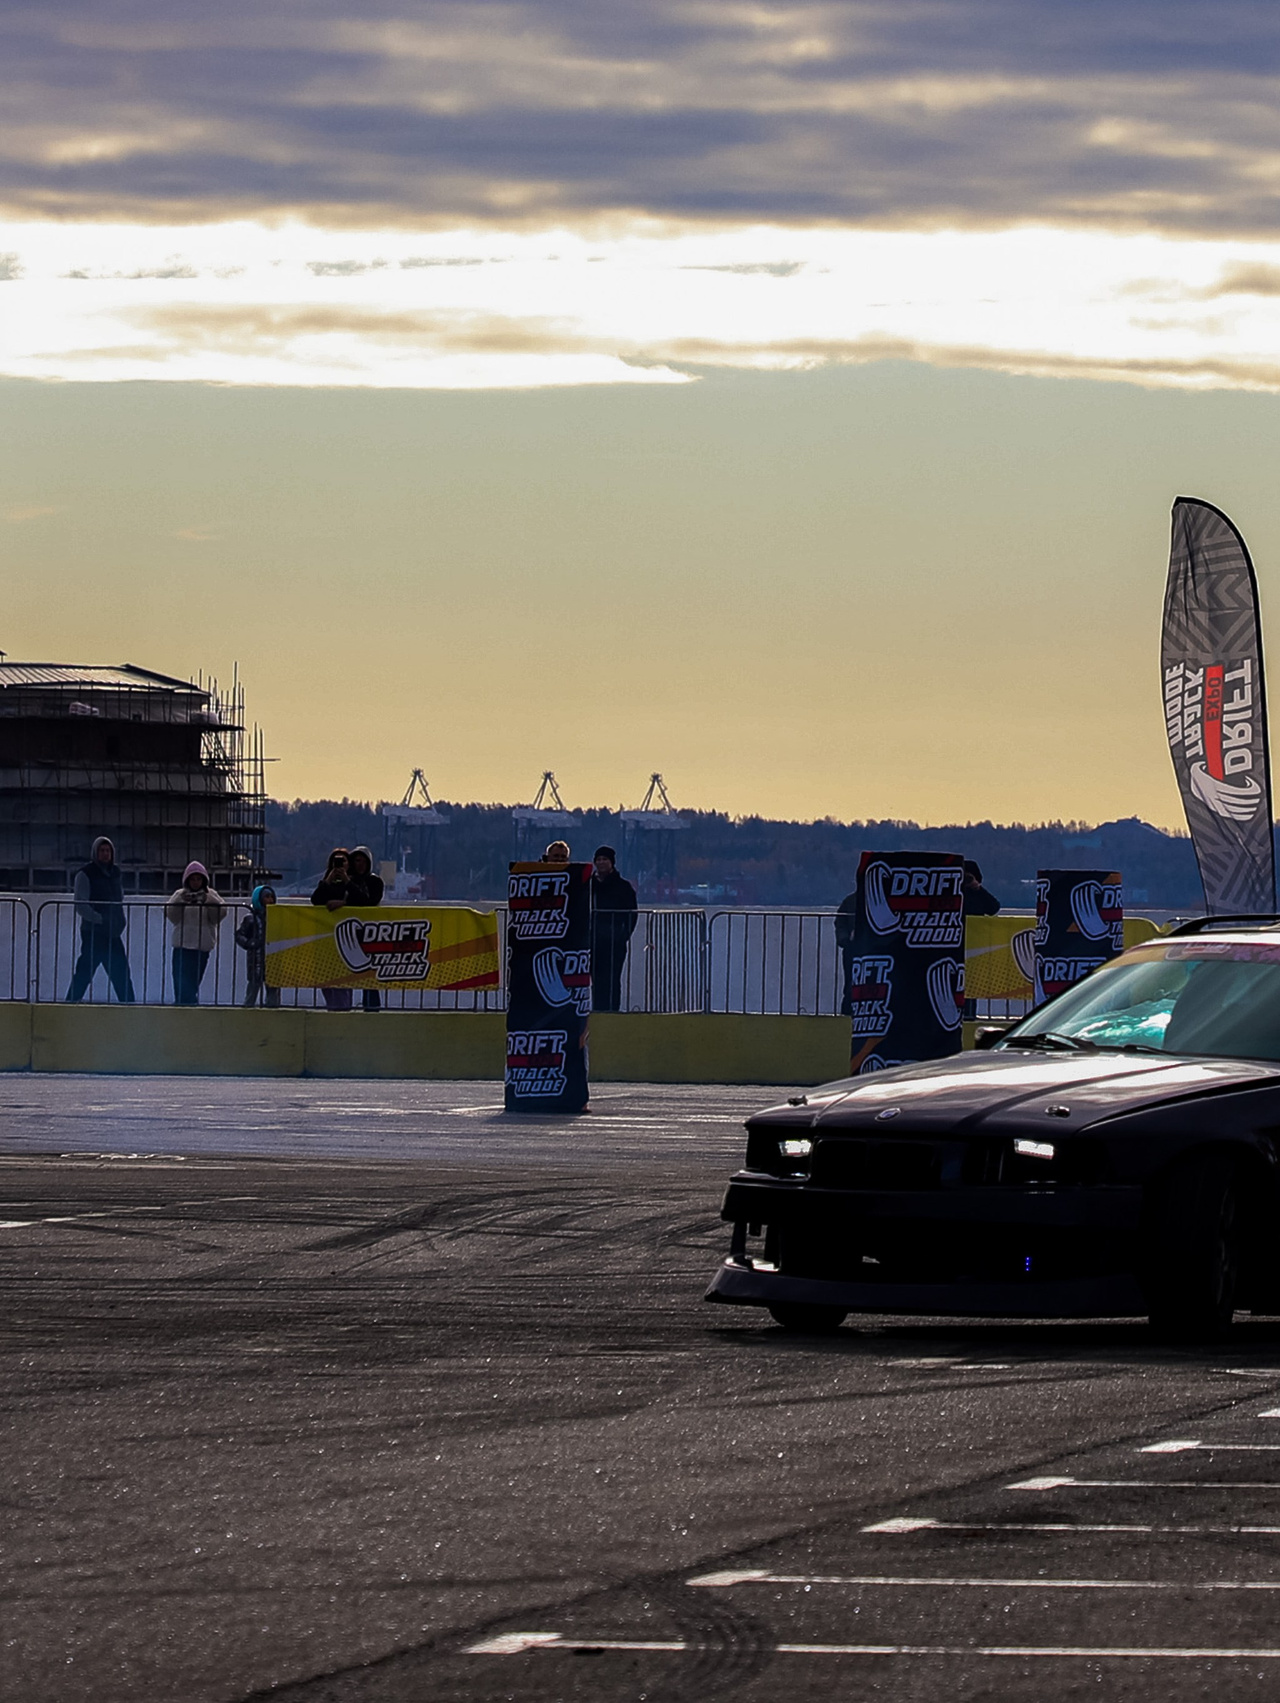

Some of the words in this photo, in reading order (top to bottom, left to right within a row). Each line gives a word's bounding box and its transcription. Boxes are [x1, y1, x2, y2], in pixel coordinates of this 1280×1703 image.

[509, 877, 566, 898] DRIFT
[890, 873, 961, 896] DRIFT
[514, 909, 562, 923] TRACK
[903, 912, 959, 926] TRACK
[362, 923, 426, 943] DRIFT
[519, 922, 565, 936] MODE
[912, 928, 960, 942] MODE
[373, 952, 423, 965] TRACK
[379, 963, 426, 976] MODE
[511, 1067, 560, 1080] TRACK
[517, 1080, 563, 1092] MODE
